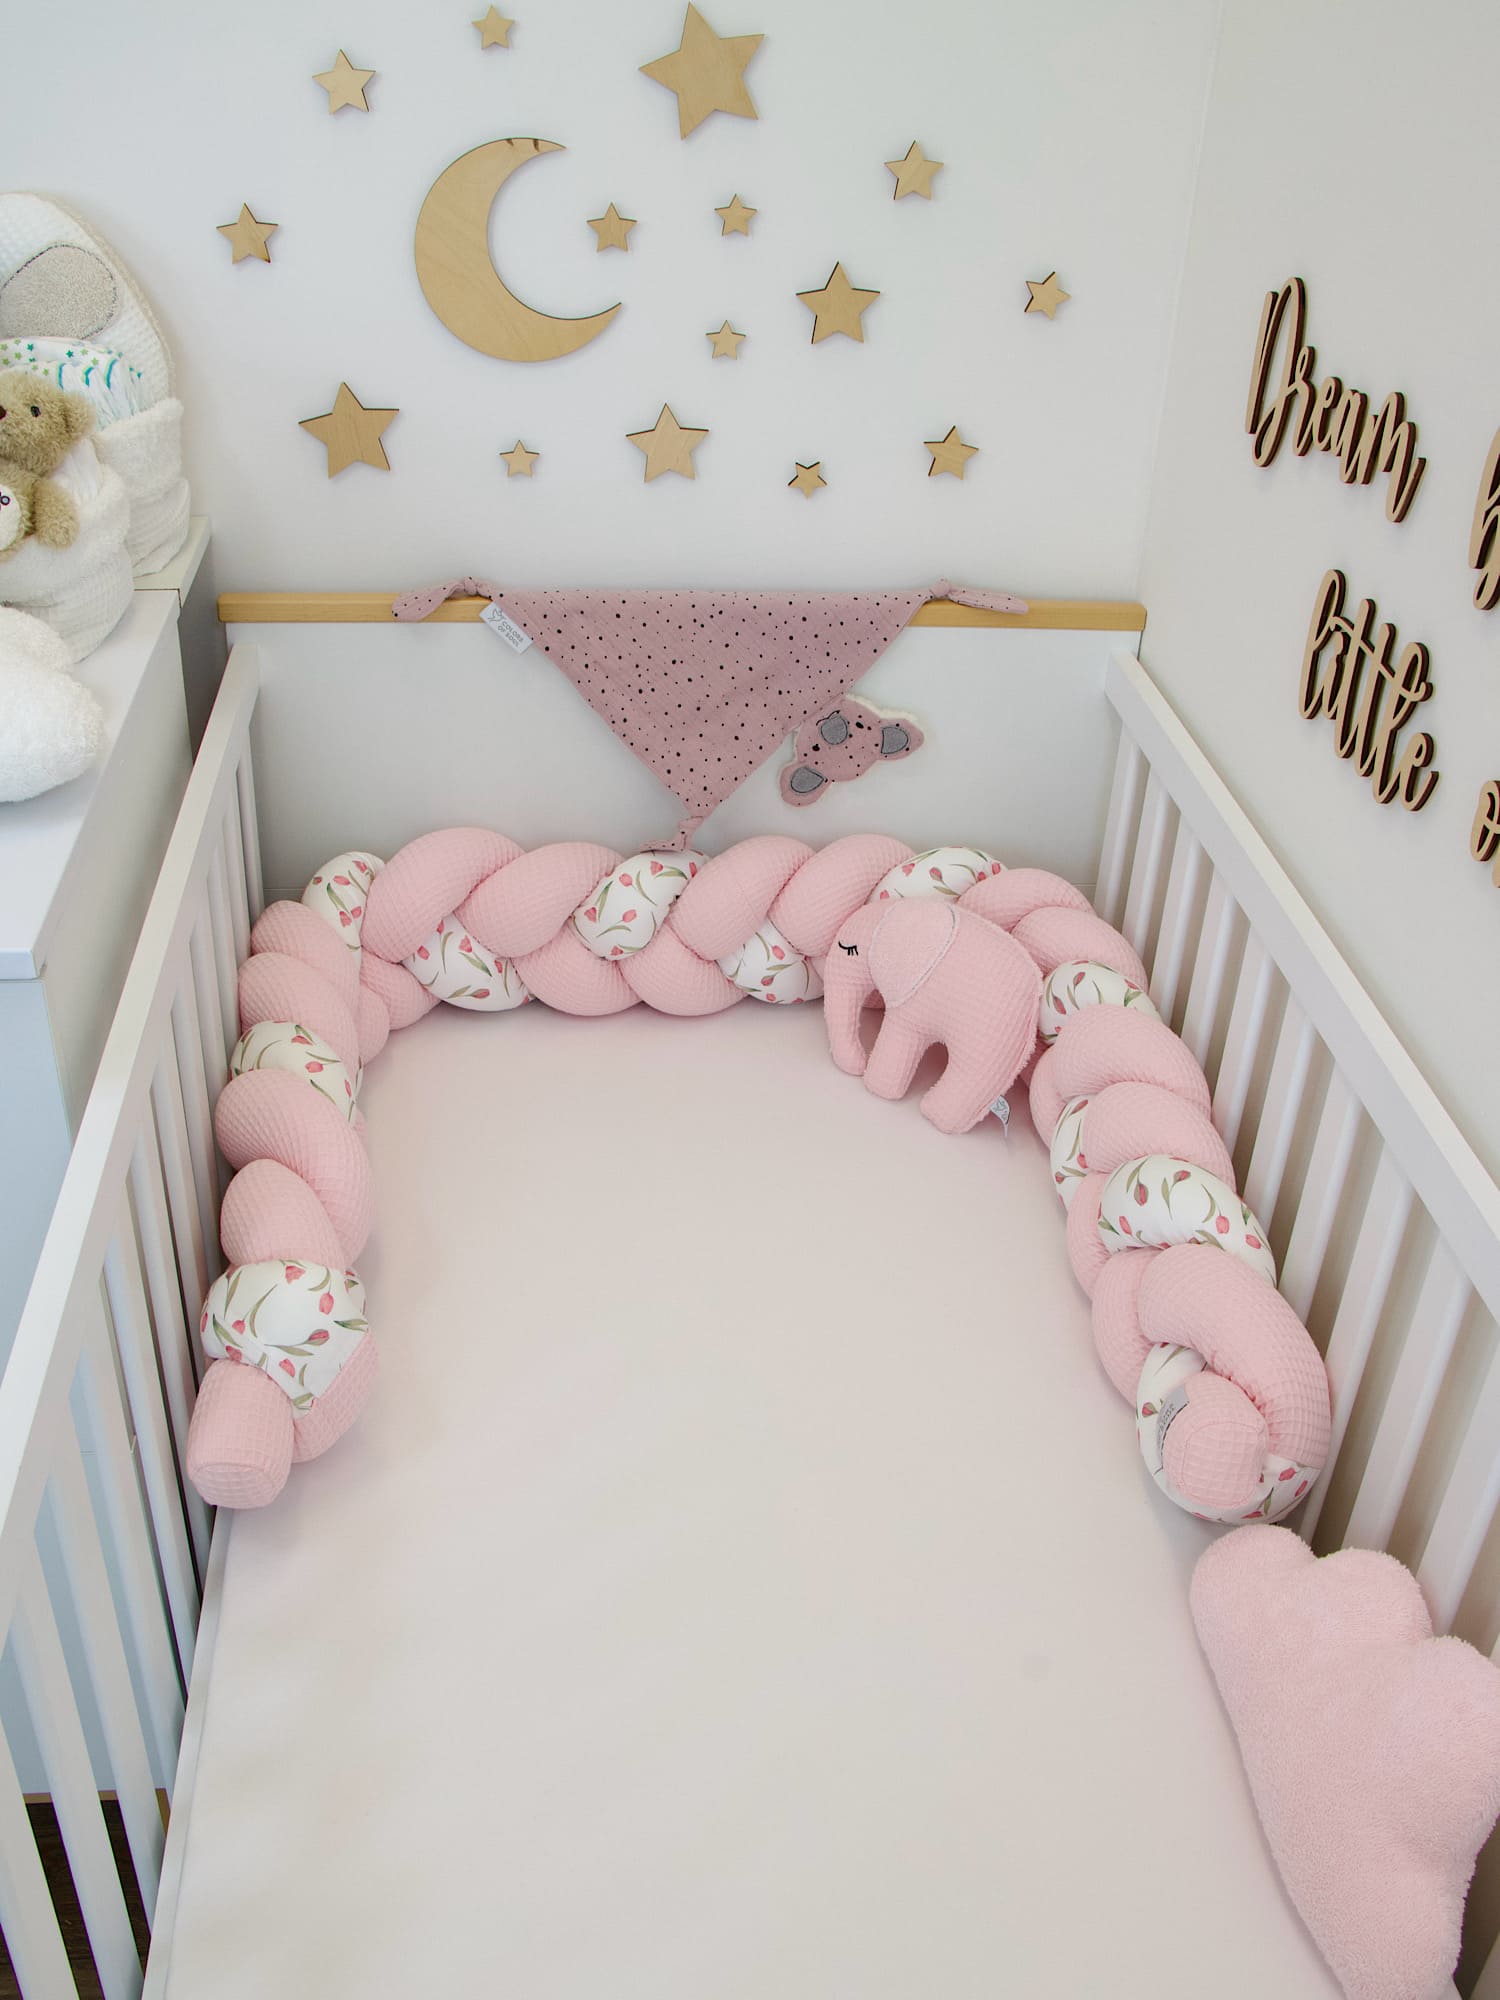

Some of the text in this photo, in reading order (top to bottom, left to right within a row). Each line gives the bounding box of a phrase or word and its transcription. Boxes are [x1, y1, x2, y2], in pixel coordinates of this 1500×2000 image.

[1245, 276, 1427, 523] Dream
[497, 625, 507, 633] OF
[501, 620, 524, 643] COLORS
